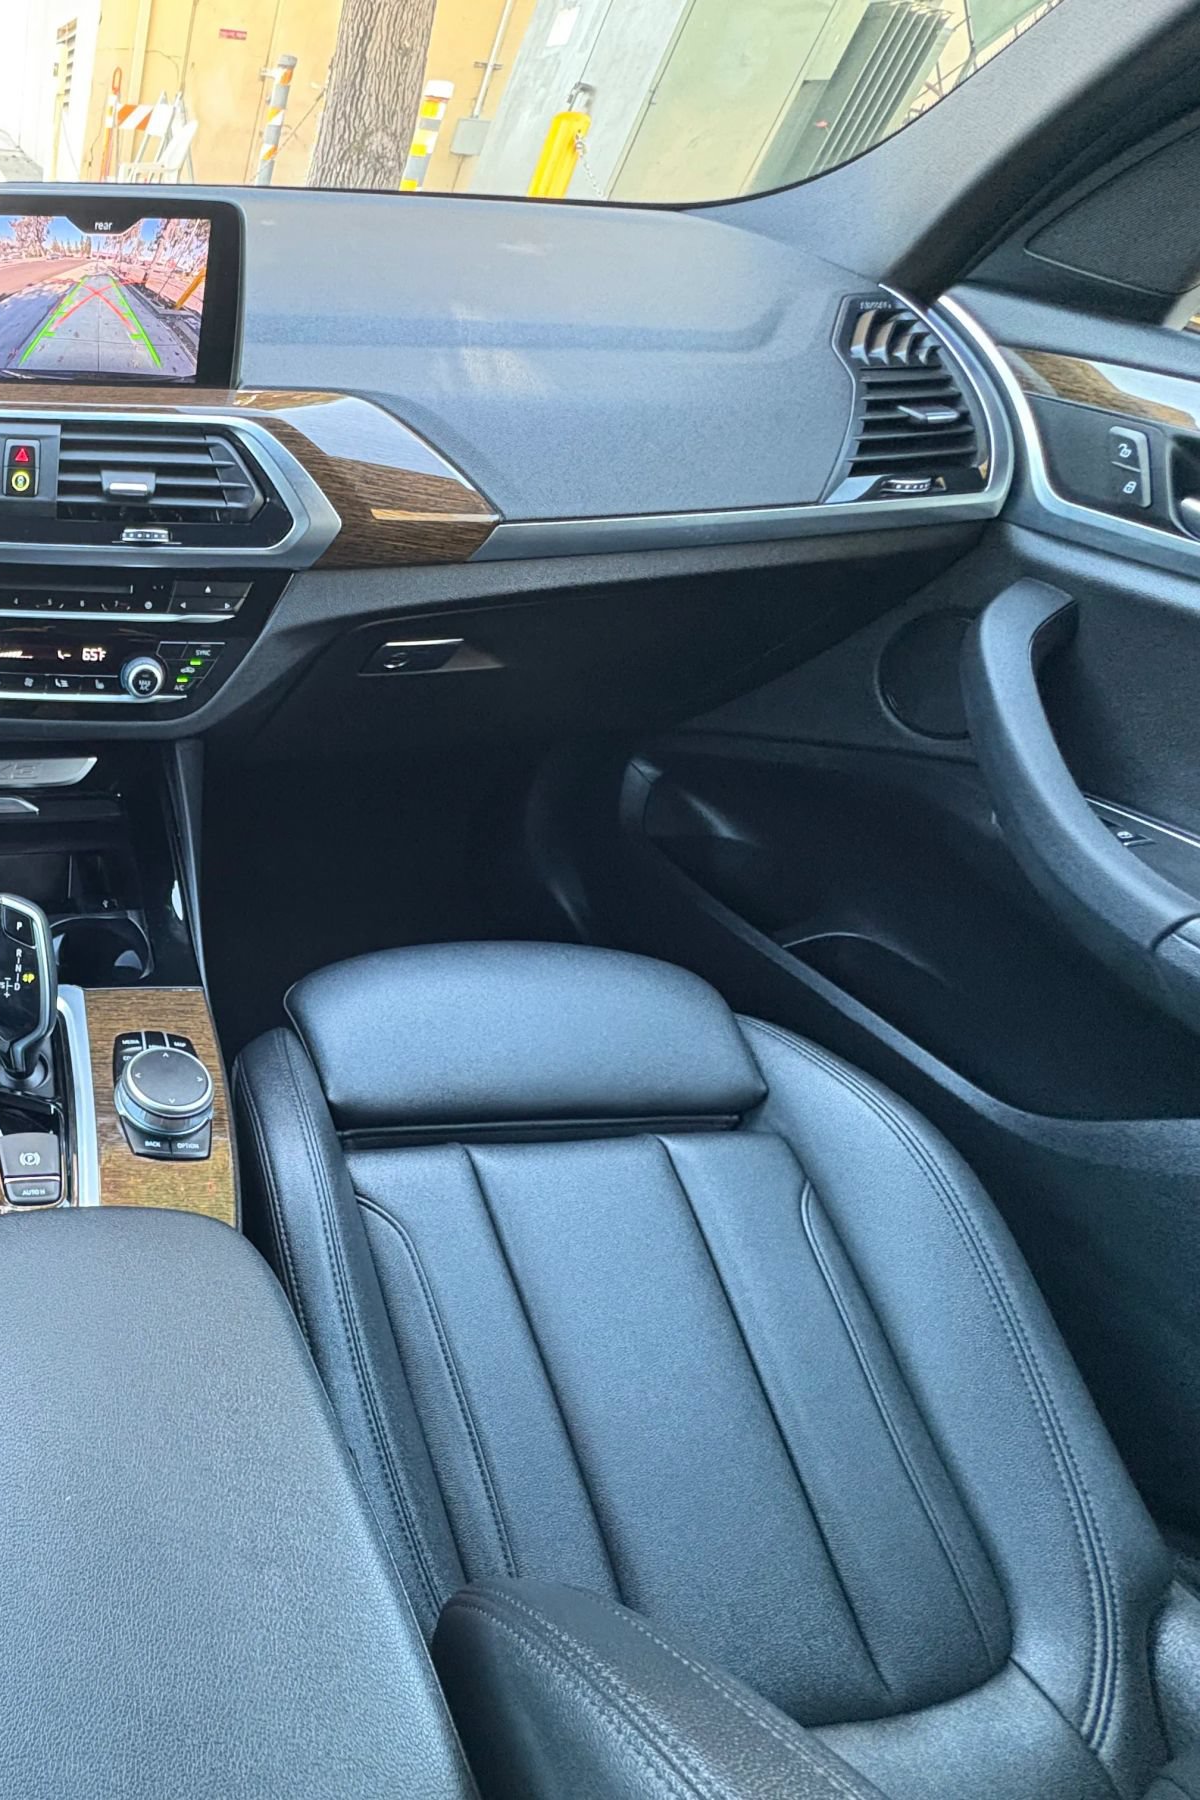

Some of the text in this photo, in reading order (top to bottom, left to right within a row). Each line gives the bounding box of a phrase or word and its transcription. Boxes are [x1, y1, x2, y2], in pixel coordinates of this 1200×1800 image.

[95, 222, 112, 230] rear
[195, 648, 211, 657] SYNC
[173, 684, 185, 692] A/C
[16, 921, 23, 931] P
[16, 948, 22, 957] R
[14, 964, 22, 972] N
[14, 982, 21, 991] D
[144, 1140, 161, 1148] BACK
[176, 1142, 200, 1150] OPTION
[21, 1188, 40, 1196] AUTO
